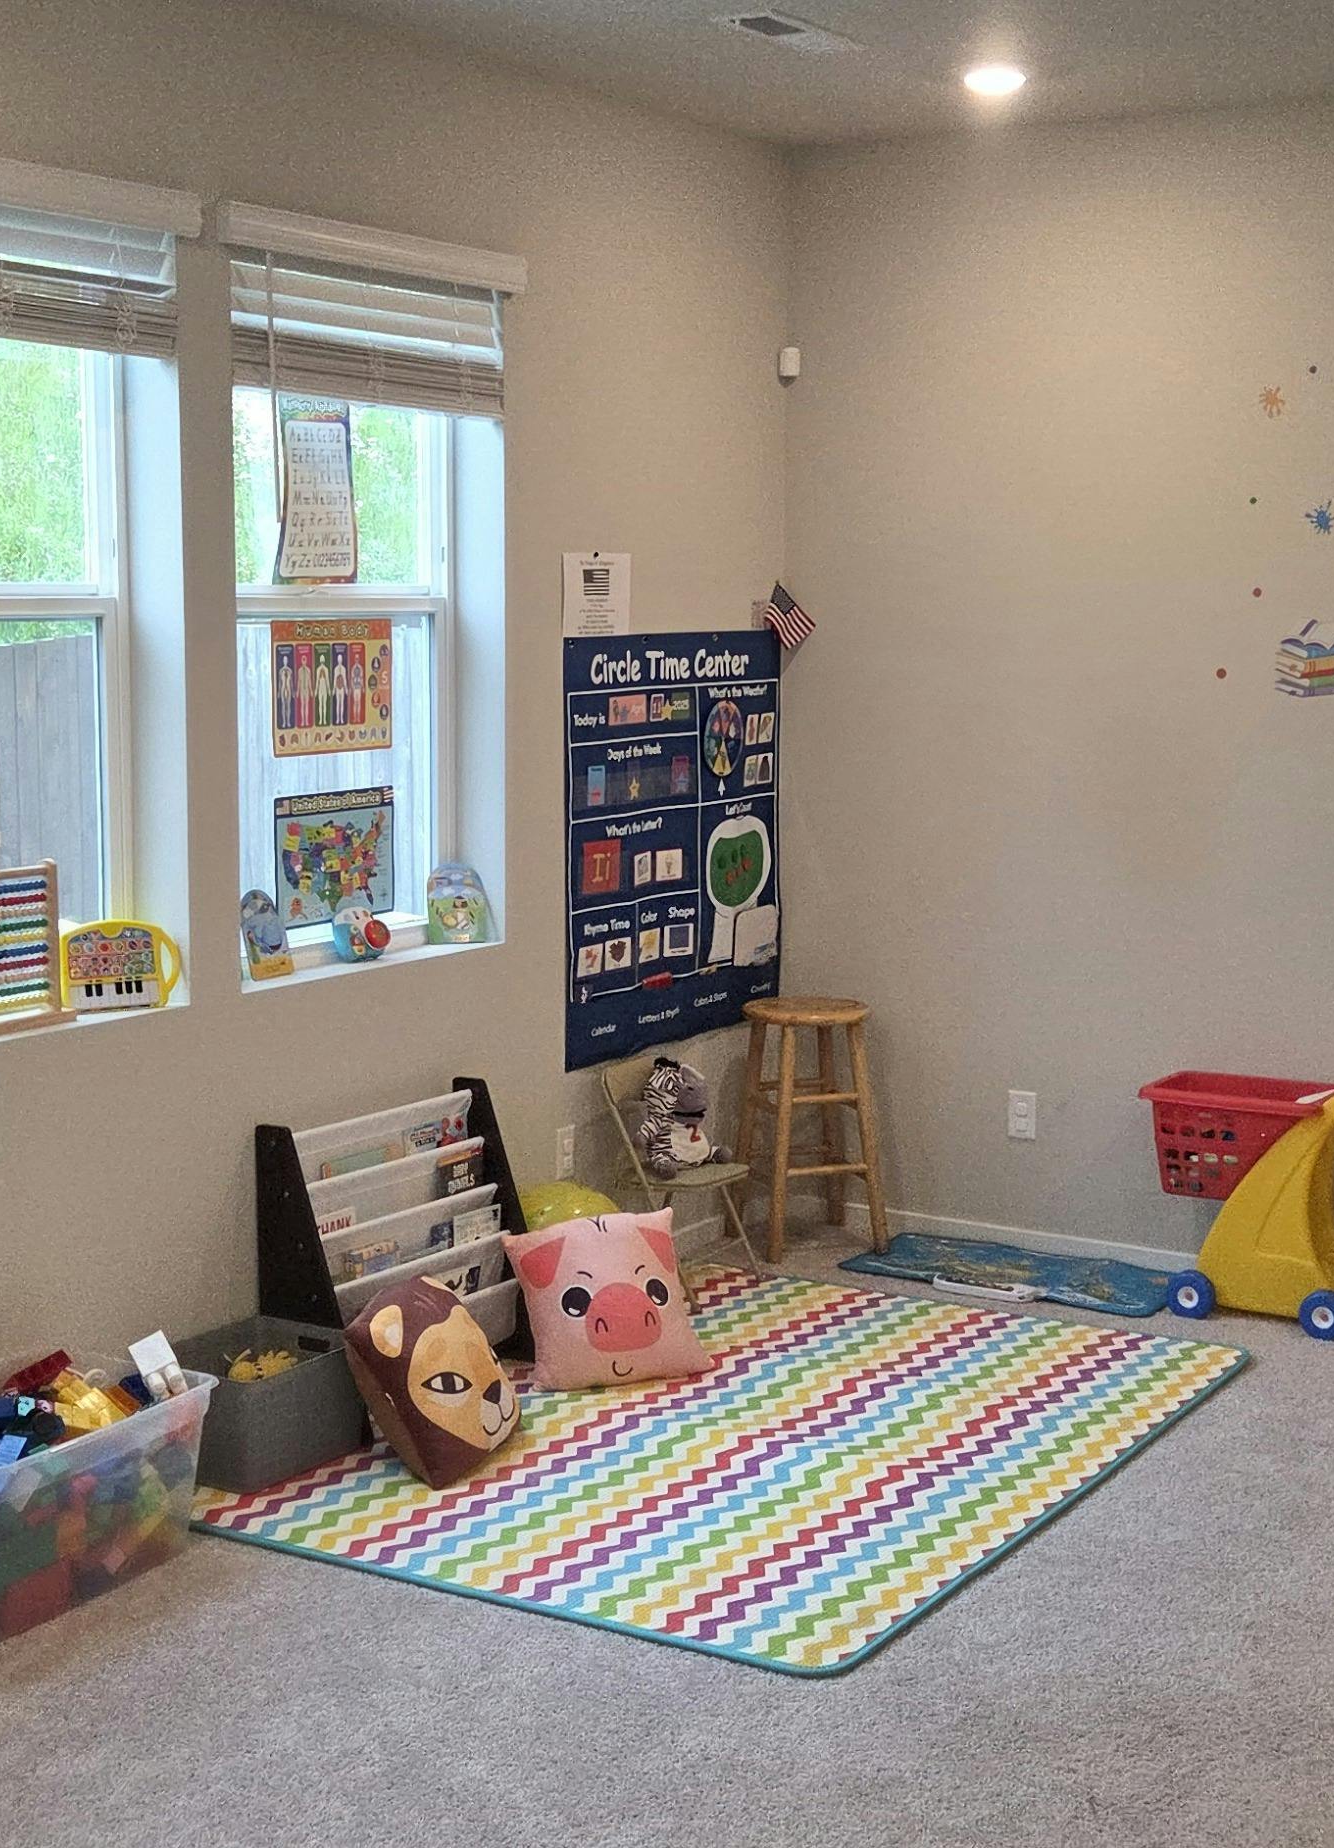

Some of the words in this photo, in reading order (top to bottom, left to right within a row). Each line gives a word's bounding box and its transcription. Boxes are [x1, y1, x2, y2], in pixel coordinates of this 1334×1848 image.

[295, 624, 336, 637] Human
[340, 623, 369, 637] Body
[589, 650, 641, 685] Circle
[645, 650, 691, 681] Time
[693, 647, 749, 679] Center
[573, 713, 598, 728] Today
[599, 712, 606, 725] is
[607, 748, 625, 762] Days
[640, 910, 658, 924] Color
[667, 906, 696, 919] Shape
[610, 918, 631, 931] Time
[590, 1023, 617, 1038] Calendar
